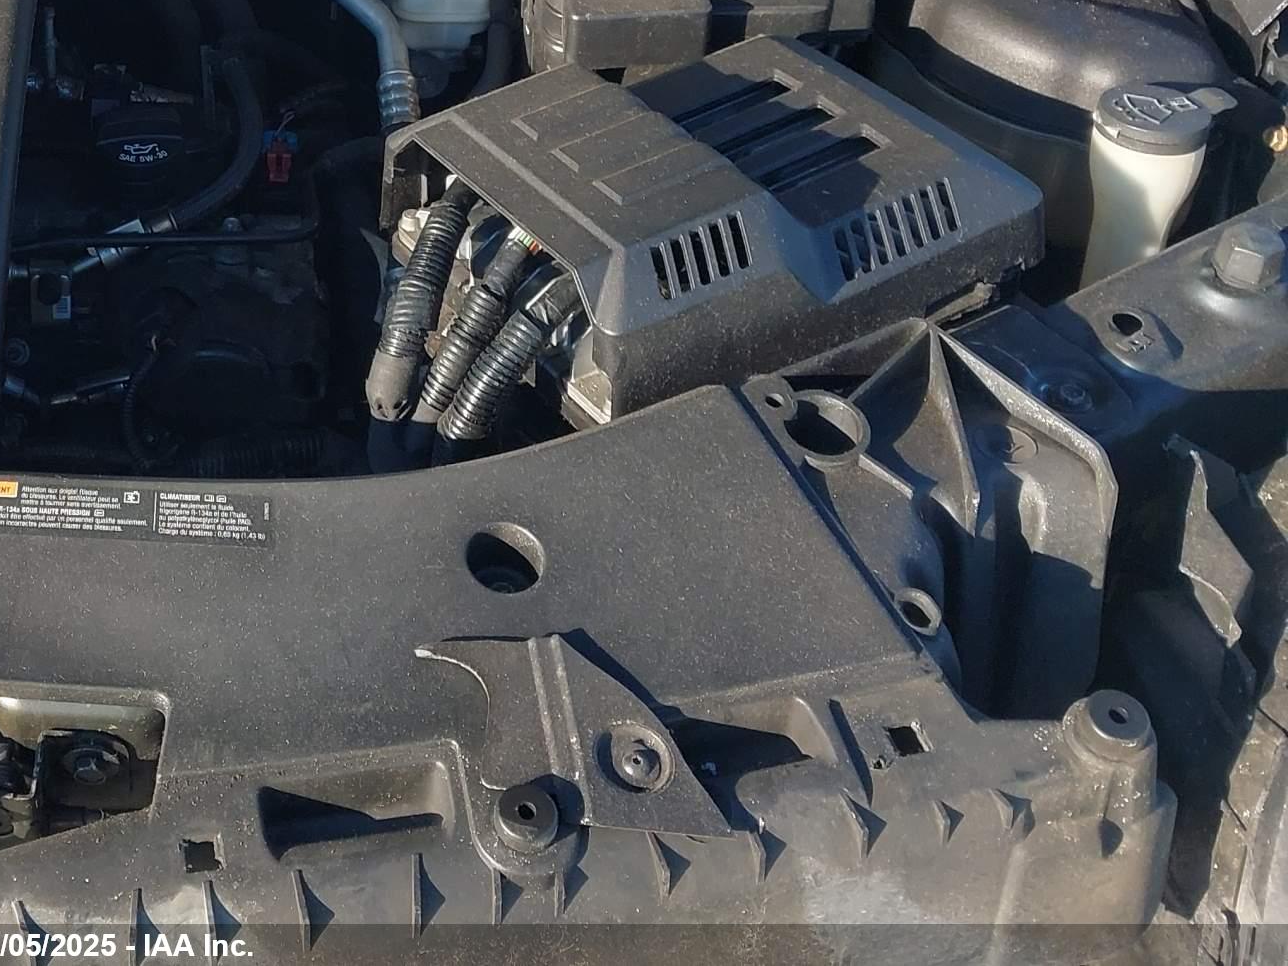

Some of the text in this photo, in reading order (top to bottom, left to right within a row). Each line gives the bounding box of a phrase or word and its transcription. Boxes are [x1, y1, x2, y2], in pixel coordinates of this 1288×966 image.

[119, 153, 136, 163] SAE
[21, 485, 47, 493] Attention
[38, 507, 59, 515] HAUTE
[59, 508, 91, 516] PRESSION
